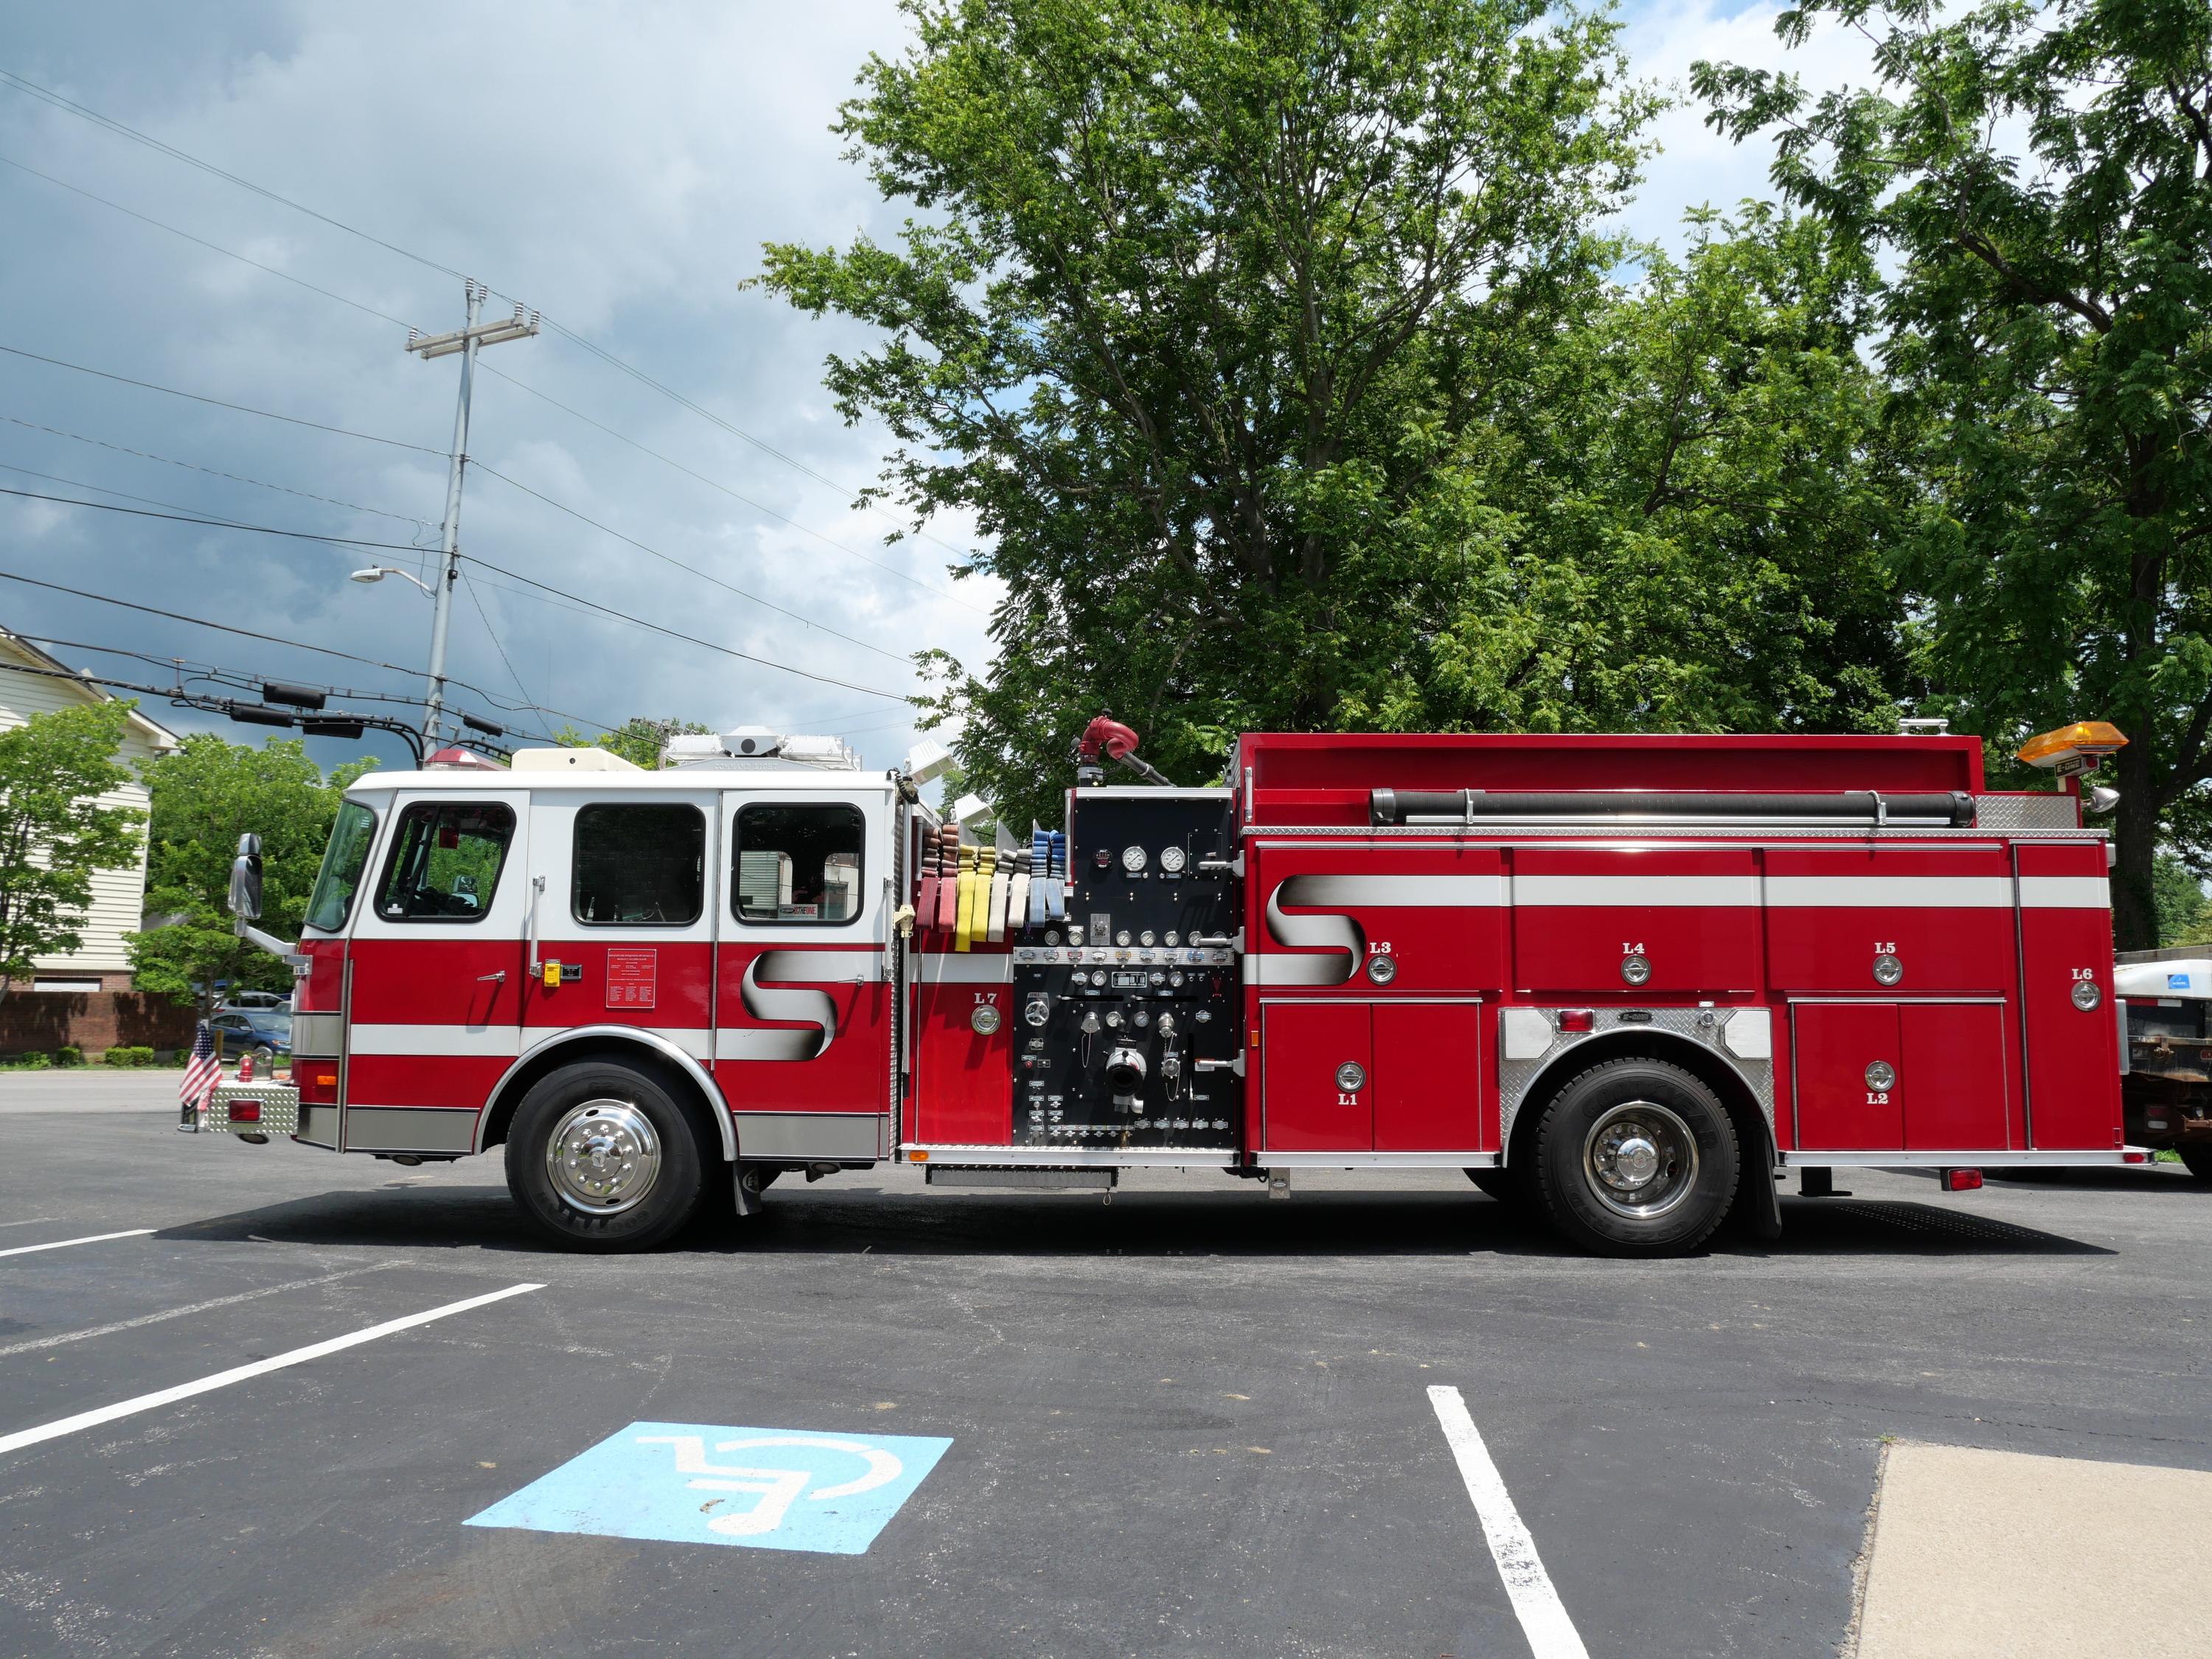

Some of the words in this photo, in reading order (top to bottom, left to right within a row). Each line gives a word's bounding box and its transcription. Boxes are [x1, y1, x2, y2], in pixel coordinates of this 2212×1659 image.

[2056, 757, 2080, 773] E-ONE
[1369, 942, 1391, 953] L3
[1622, 942, 1645, 954] L4
[1874, 942, 1896, 954] L5
[2071, 968, 2093, 980] L6
[1338, 1093, 1357, 1105] L1
[1866, 1093, 1888, 1105] L2
